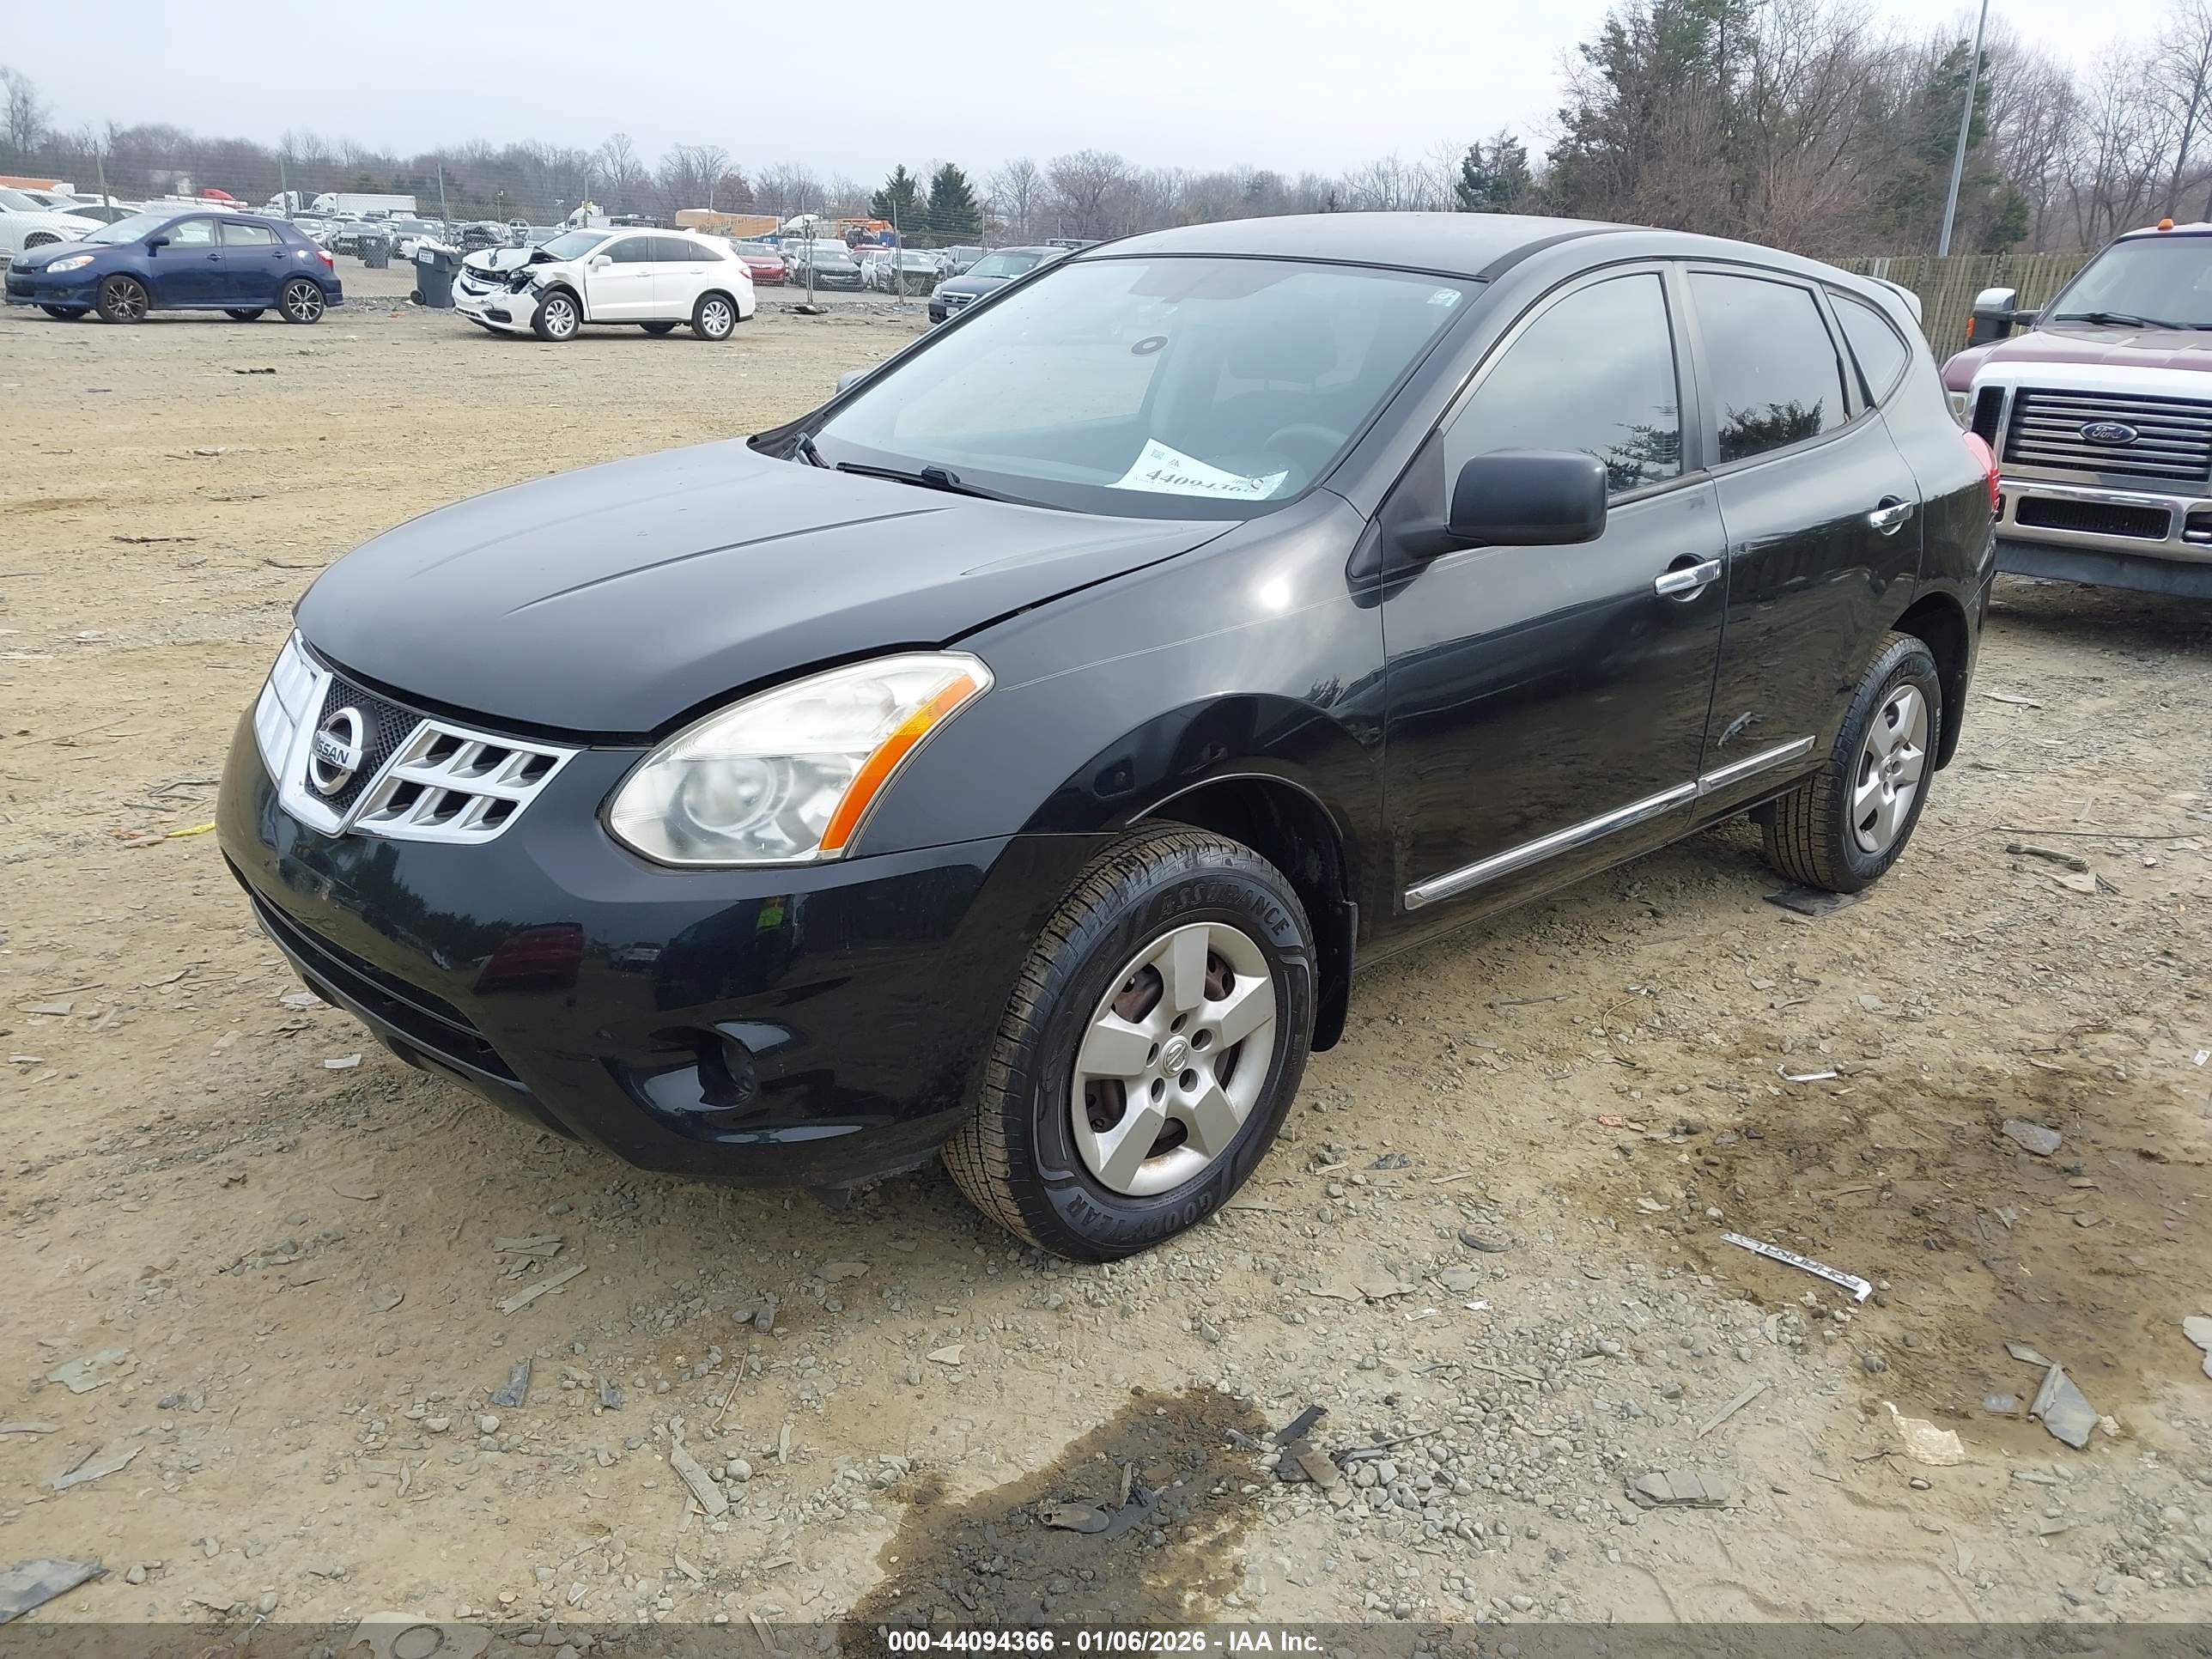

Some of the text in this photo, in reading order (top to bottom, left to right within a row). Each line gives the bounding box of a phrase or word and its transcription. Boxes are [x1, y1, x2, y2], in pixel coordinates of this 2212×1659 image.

[2092, 425, 2124, 439] Ford
[1161, 881, 1290, 936] ASSURANCE
[1764, 1245, 1862, 1287] POHANKA
